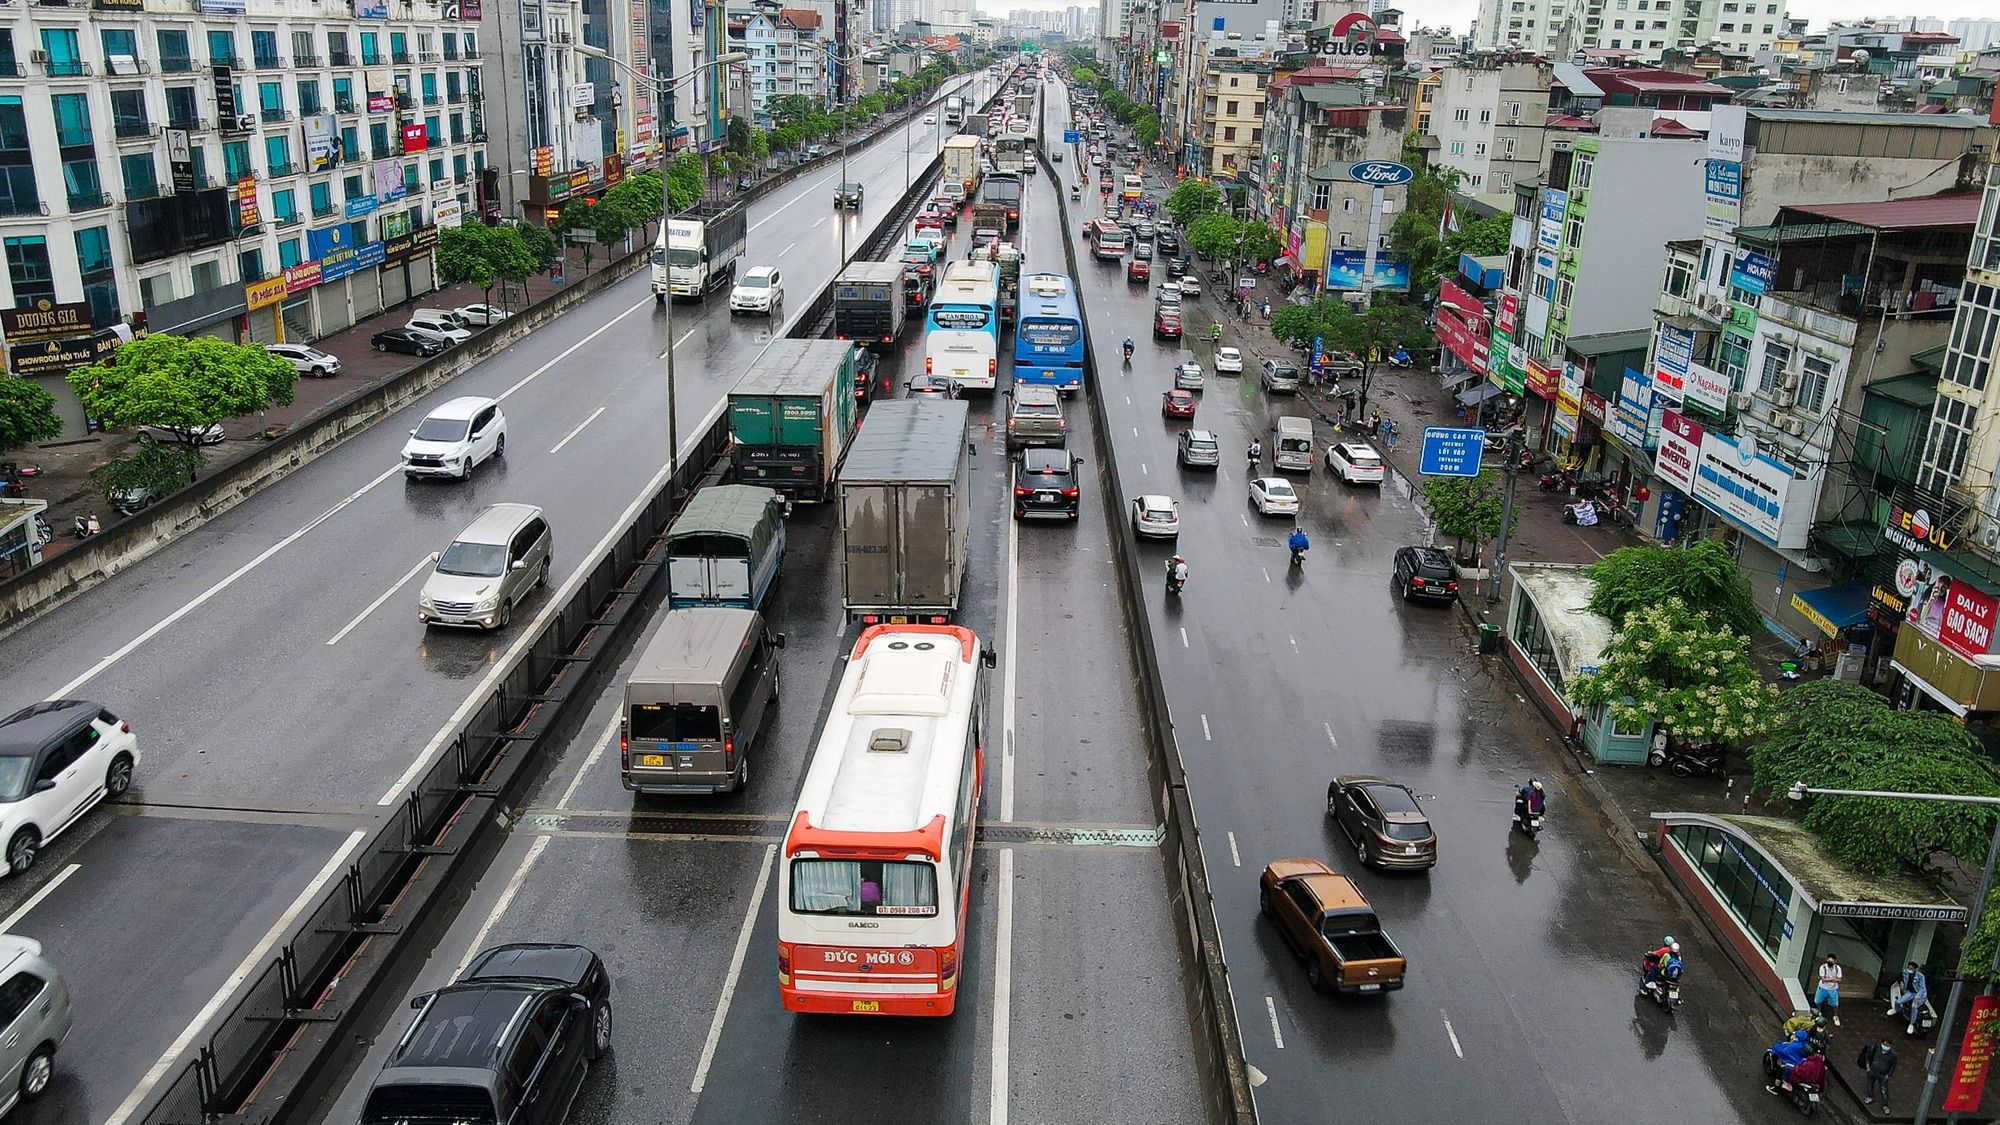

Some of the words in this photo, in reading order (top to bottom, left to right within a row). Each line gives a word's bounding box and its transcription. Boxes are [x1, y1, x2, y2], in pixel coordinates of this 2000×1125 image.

[1178, 23, 1186, 68] HOTEL
[1719, 133, 1740, 150] kaiyo
[1362, 164, 1402, 182] Ford
[58, 309, 78, 324] GIA
[18, 355, 60, 366] SHOWROOM
[1696, 374, 1726, 396] Nagakawa
[1679, 422, 1690, 436] LG
[1438, 447, 1449, 455] LỐI
[1882, 593, 1903, 613] BUFFET
[1957, 593, 1974, 613] ĐẠI
[1976, 602, 1989, 619] LÝ
[1946, 608, 1965, 634] GẠO
[1964, 619, 1989, 648] SẠCH
[1880, 908, 1901, 917] CHO
[824, 950, 858, 963] ĐỨC
[1976, 1008, 1998, 1019] 30-4
